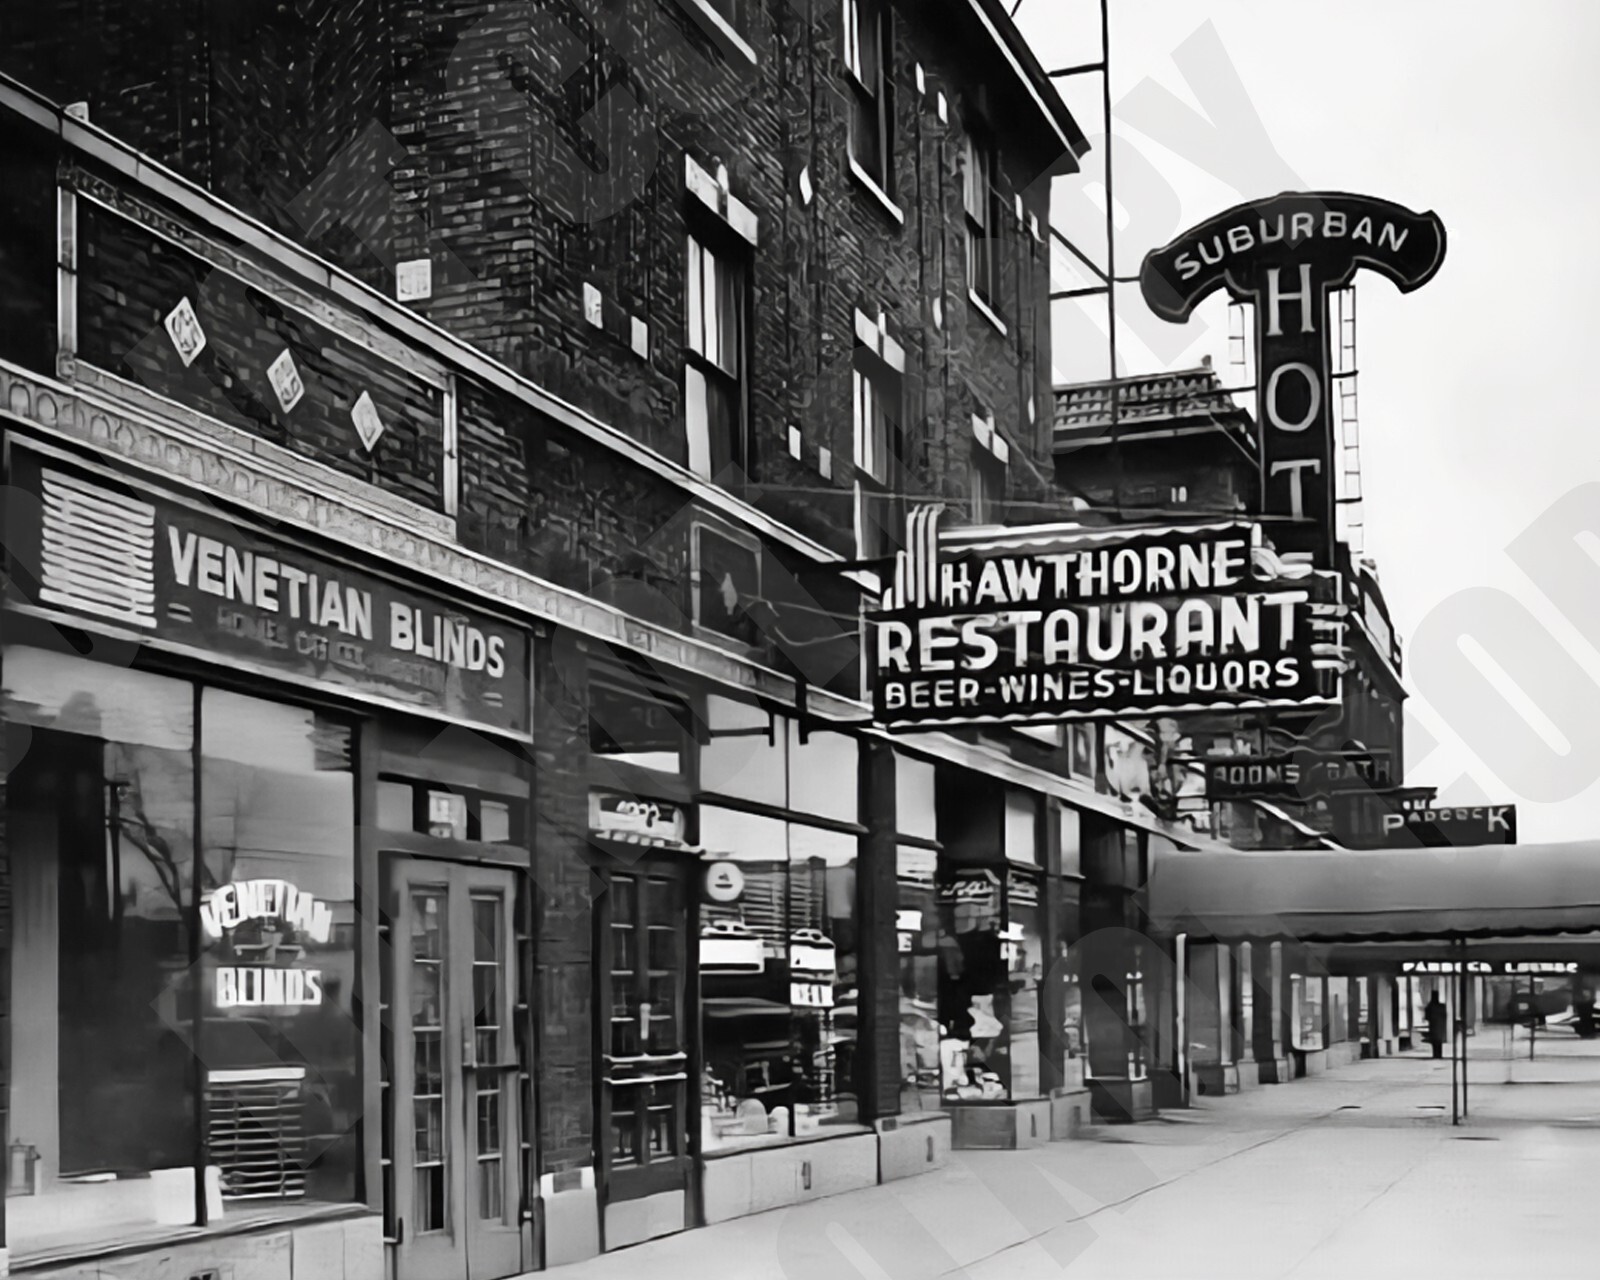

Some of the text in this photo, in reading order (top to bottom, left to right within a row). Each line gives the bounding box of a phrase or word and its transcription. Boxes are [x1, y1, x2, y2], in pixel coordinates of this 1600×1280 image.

[1174, 211, 1409, 281] SUBURBAN
[167, 525, 374, 641] VENETIAN
[390, 601, 505, 678] BLINDS
[941, 540, 1245, 606] HAWTHORNE
[877, 591, 1309, 675] RESTAURANT
